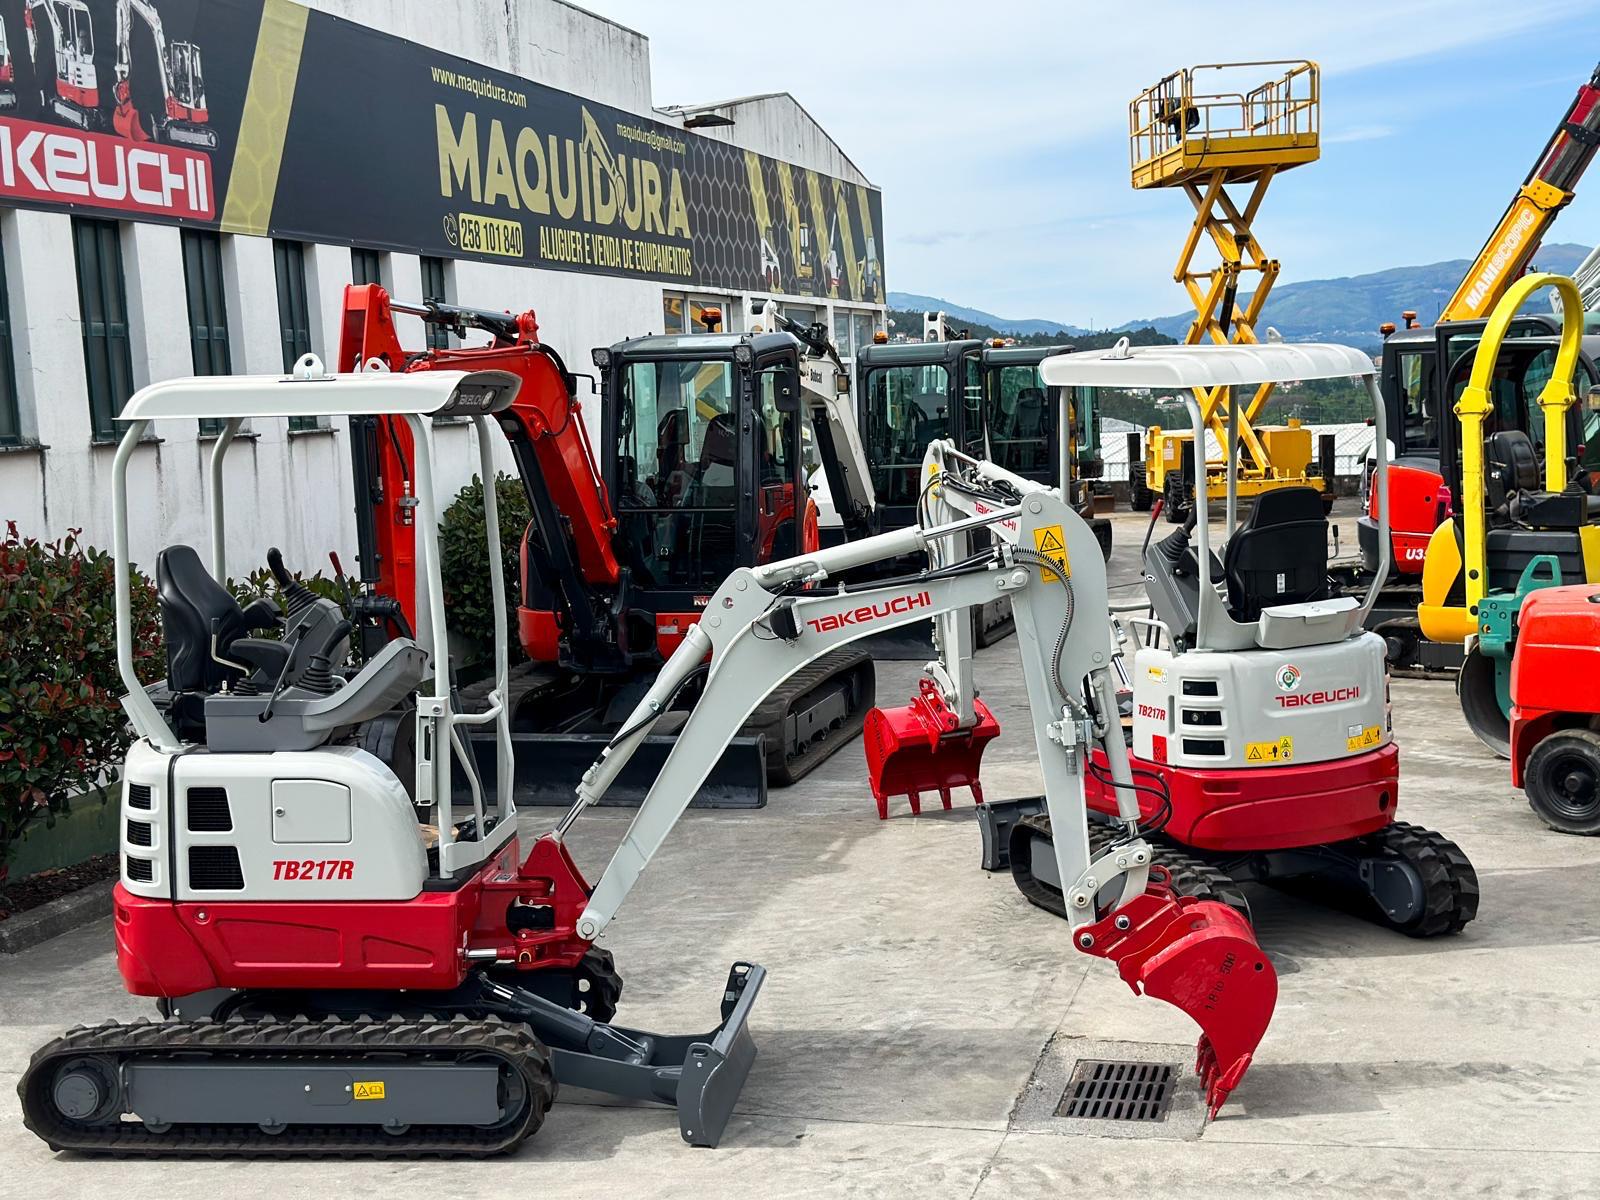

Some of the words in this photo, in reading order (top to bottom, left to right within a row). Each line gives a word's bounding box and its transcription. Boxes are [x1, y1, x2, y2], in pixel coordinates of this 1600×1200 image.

[430, 66, 527, 109] www.maquidura.com
[435, 103, 692, 239] MAQUIDURA
[461, 218, 481, 250] 258
[483, 222, 502, 252] 101
[503, 224, 522, 255] 840
[539, 225, 584, 264] ALUGUER
[584, 232, 592, 264] E
[591, 233, 622, 268] VENDA
[622, 238, 634, 269] DE
[634, 240, 692, 277] EQUIPAMENTOS
[1465, 208, 1536, 311] MANISCOPIC
[1405, 548, 1426, 560] U3
[807, 591, 932, 633] TAKEUCHI
[1138, 704, 1166, 721] TB217R
[1275, 685, 1359, 708] TAKEUCHI
[272, 859, 355, 881] TB217R
